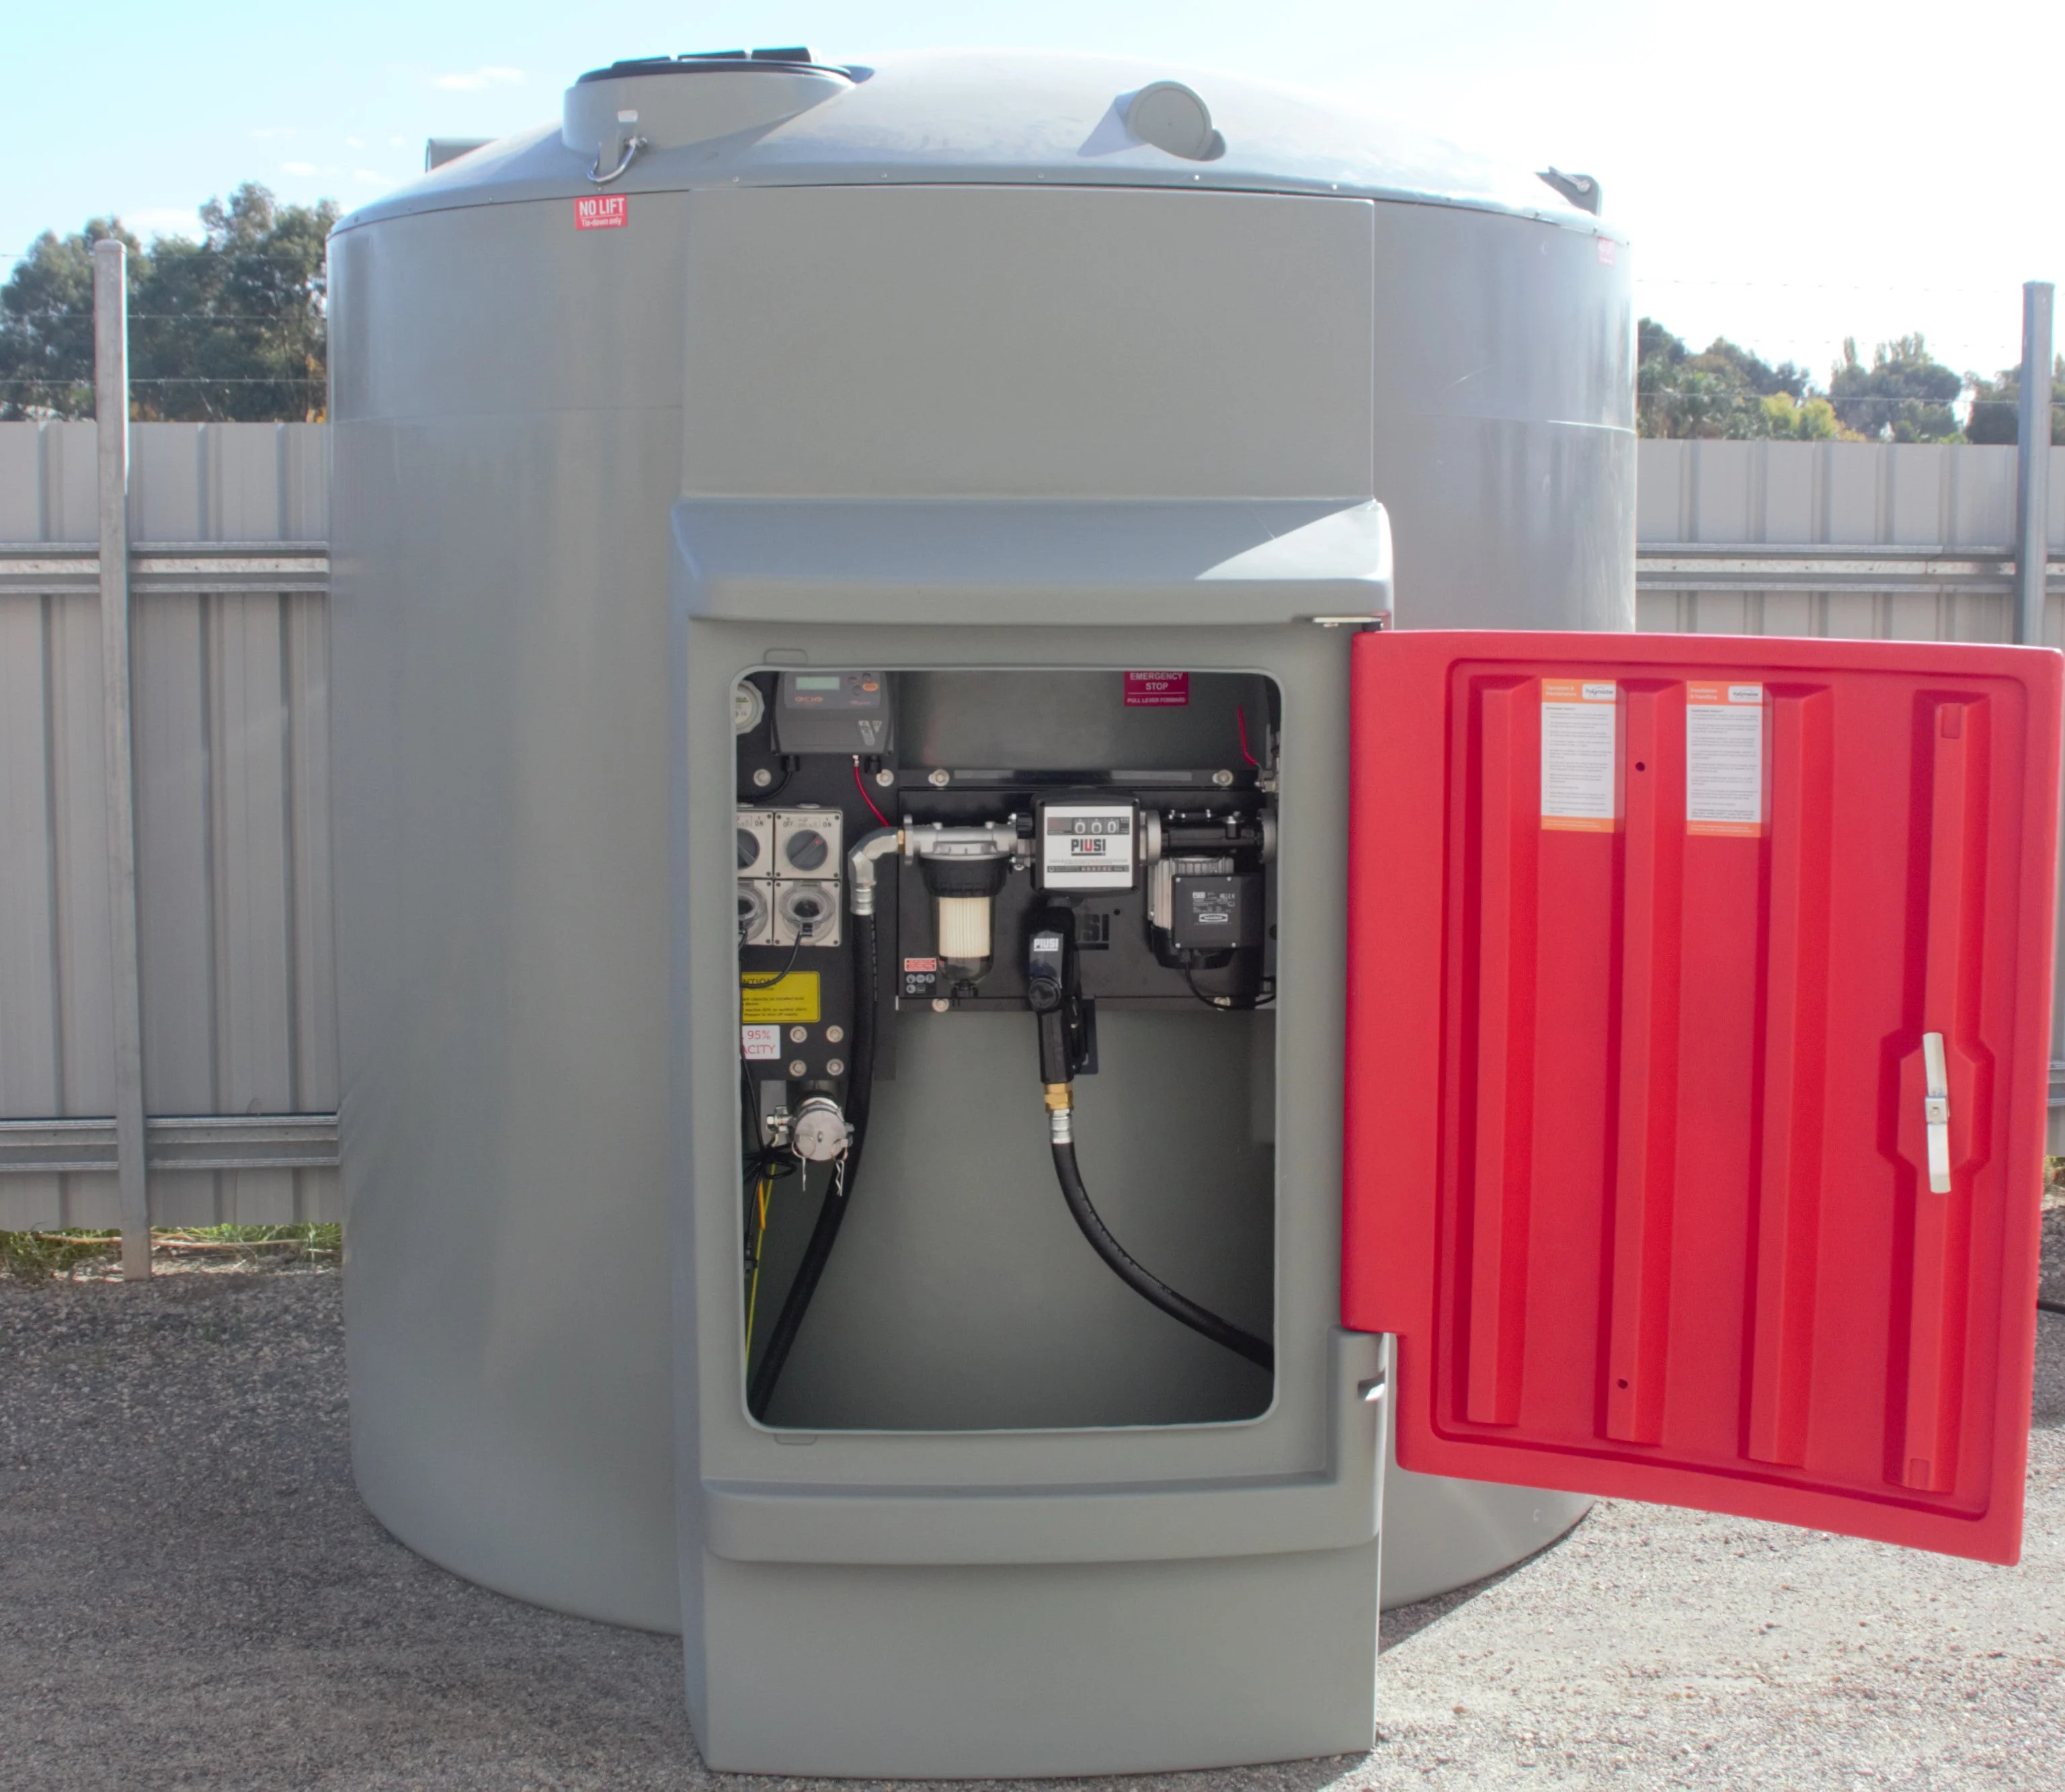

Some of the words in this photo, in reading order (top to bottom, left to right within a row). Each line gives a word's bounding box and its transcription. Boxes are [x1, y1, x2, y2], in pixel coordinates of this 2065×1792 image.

[579, 200, 596, 216] NO
[599, 198, 624, 214] LIFT
[609, 217, 622, 227] only
[1130, 672, 1183, 680] EMERGENCY
[1145, 682, 1168, 690] STOP
[1071, 838, 1106, 852] PIUSI
[1033, 938, 1059, 949] PIUSI
[747, 1030, 771, 1040] 95%
